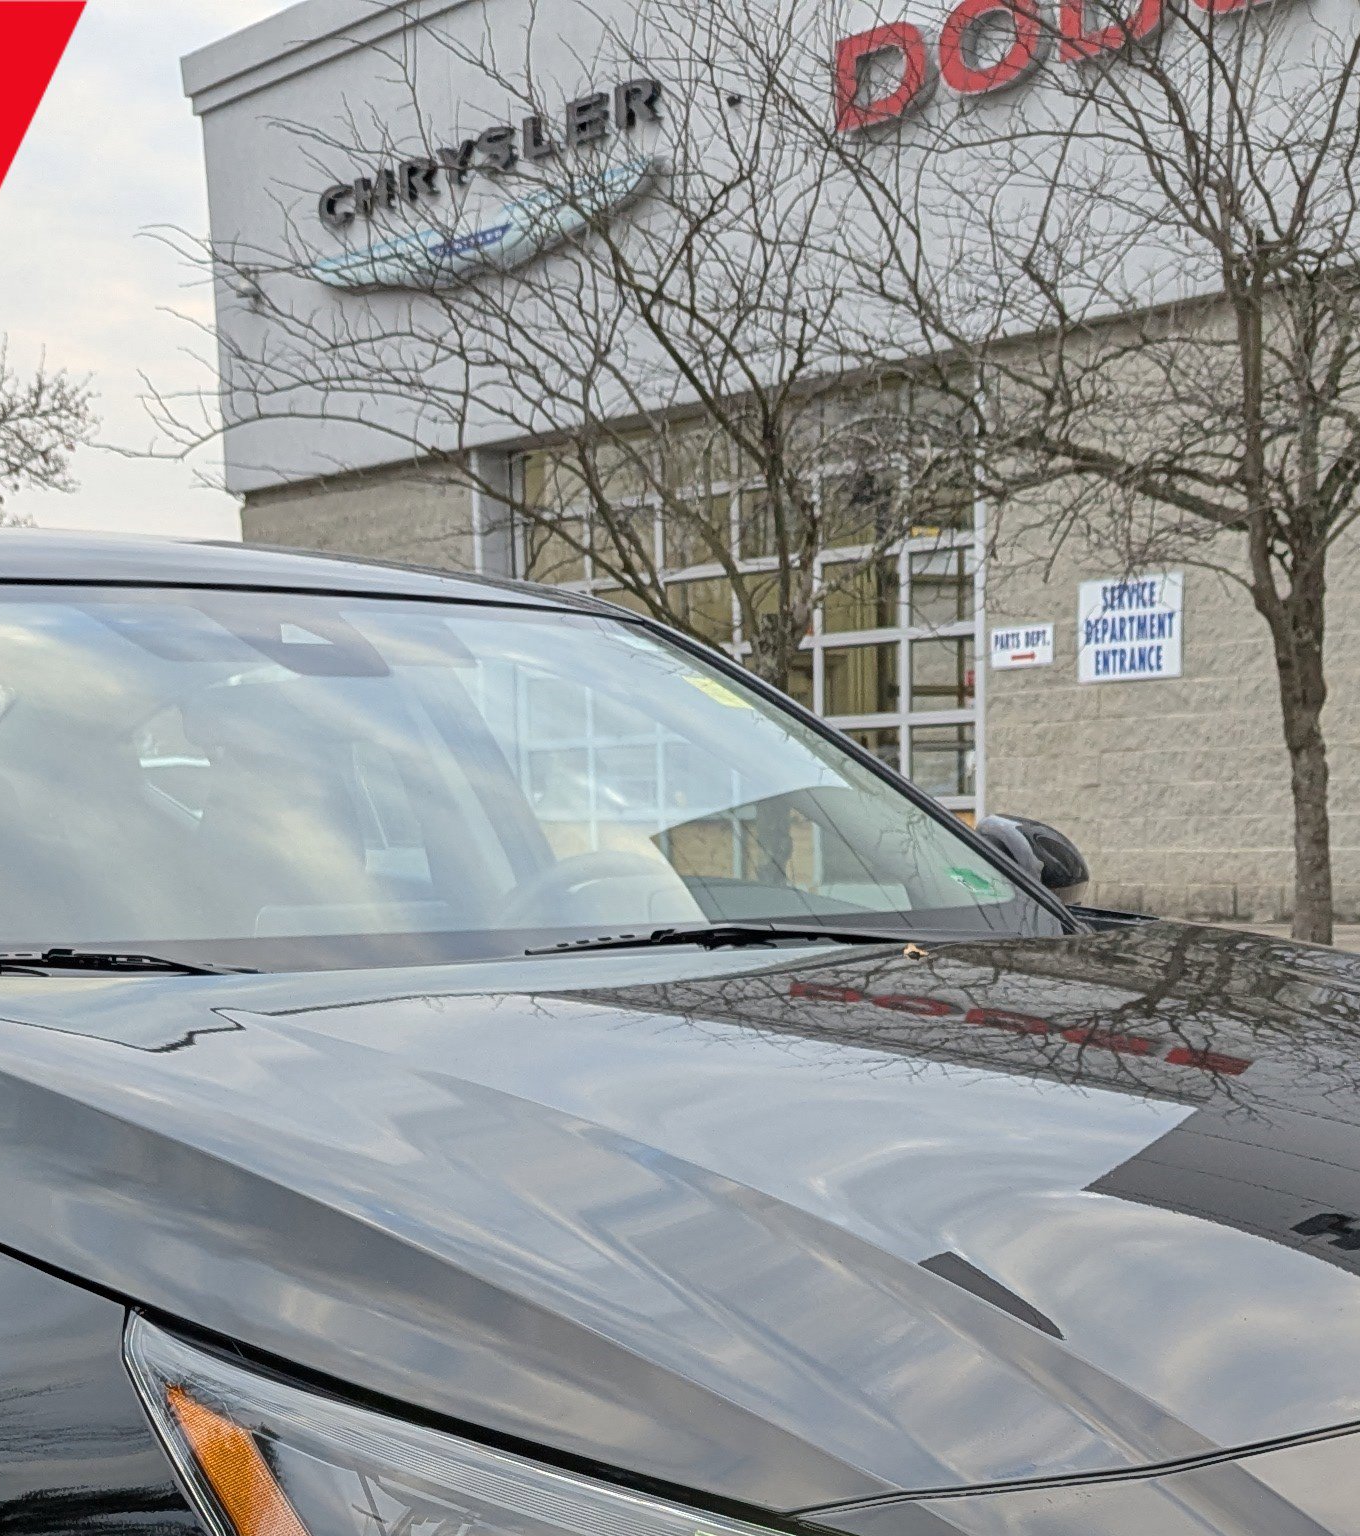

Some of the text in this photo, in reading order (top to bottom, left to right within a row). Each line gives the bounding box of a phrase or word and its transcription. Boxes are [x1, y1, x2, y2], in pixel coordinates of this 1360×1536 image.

[318, 78, 662, 231] CHRYSLER
[1102, 581, 1156, 612] SERVICE
[994, 633, 1020, 649] PARTS
[1085, 611, 1175, 646] DEPARTMENT
[1095, 645, 1163, 676] ENTRANCE
